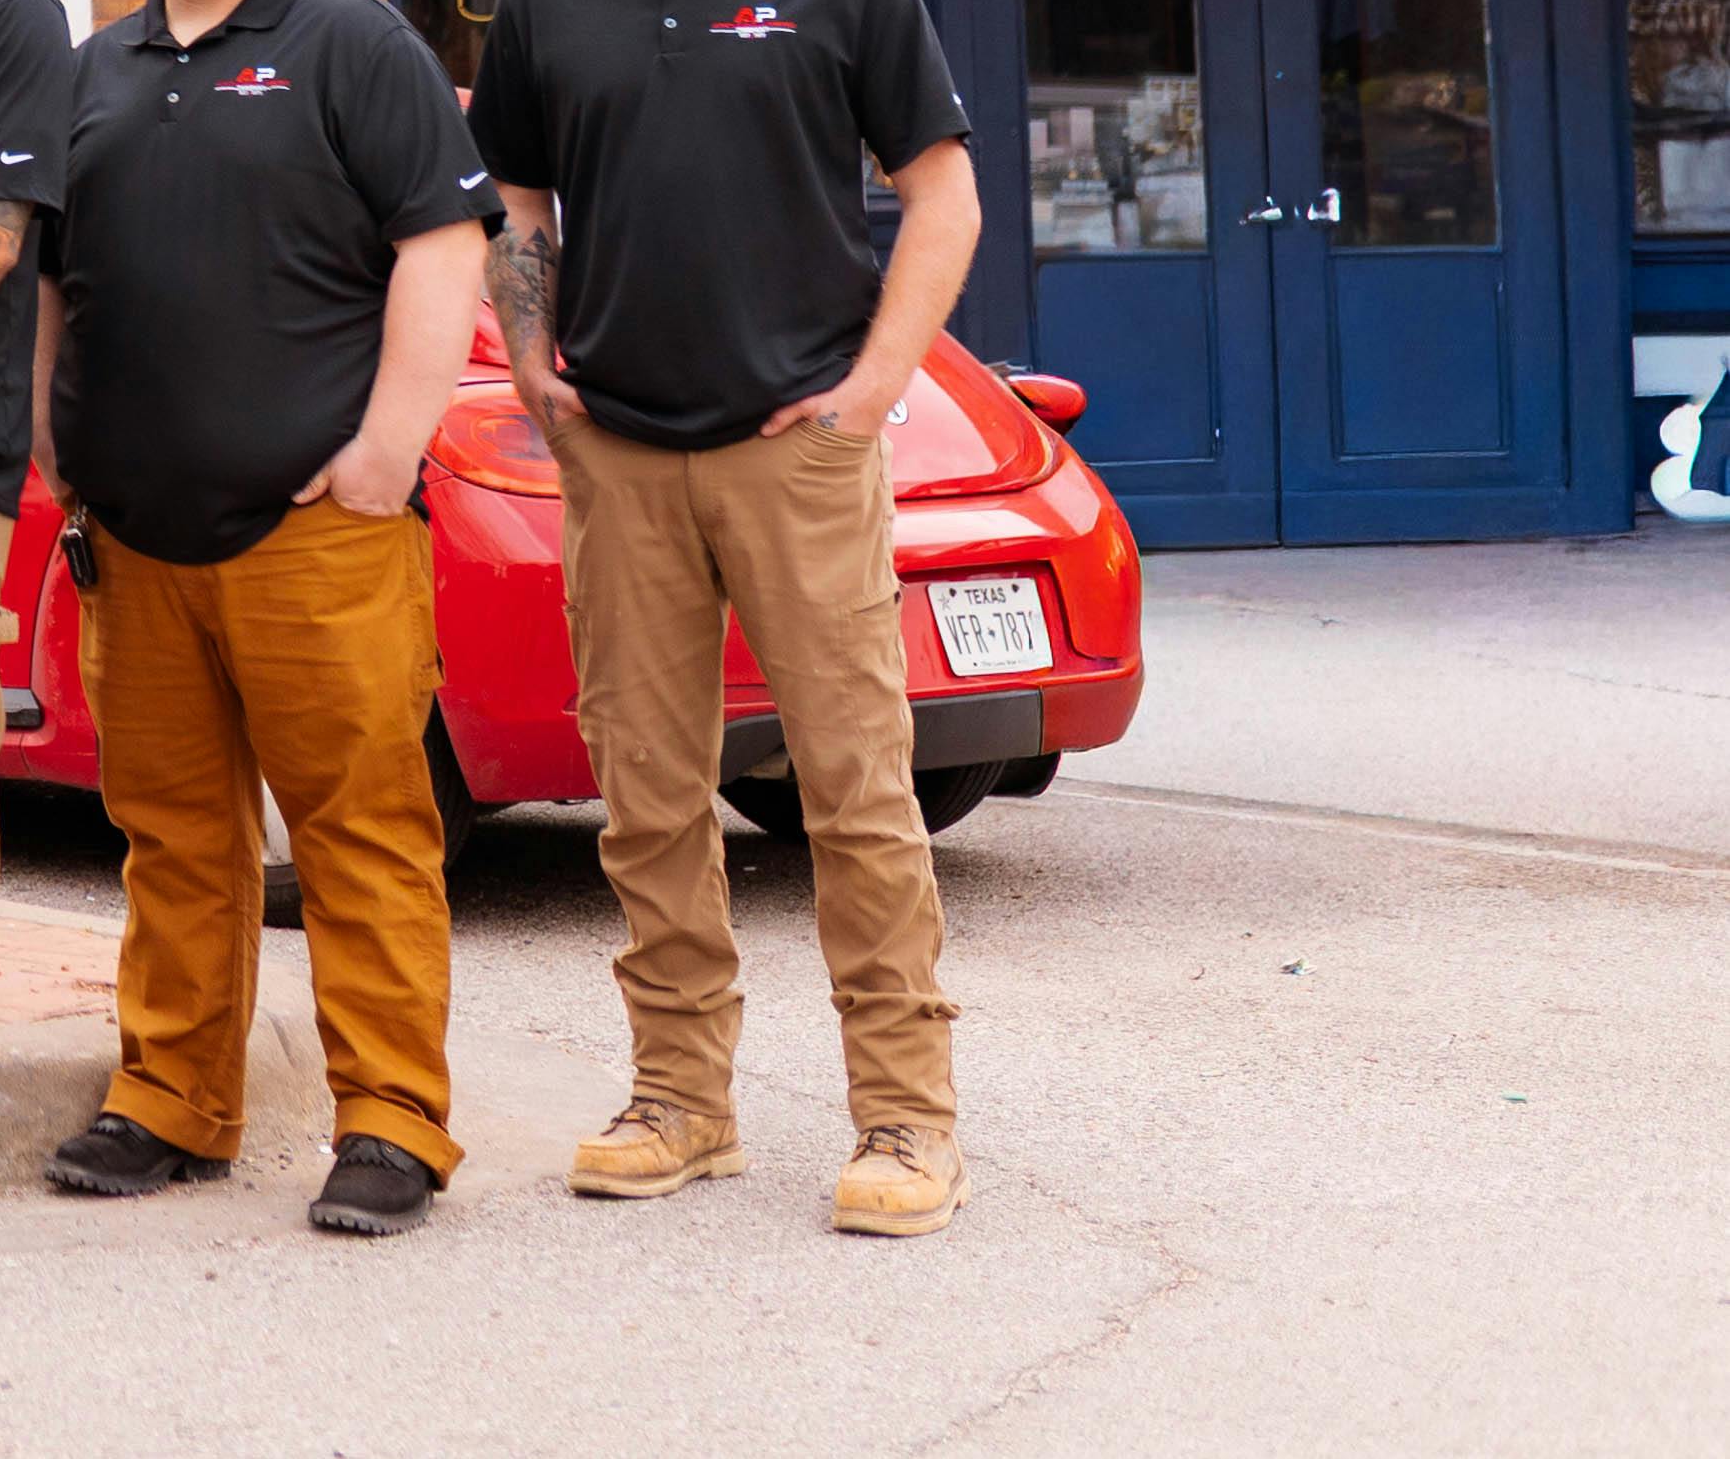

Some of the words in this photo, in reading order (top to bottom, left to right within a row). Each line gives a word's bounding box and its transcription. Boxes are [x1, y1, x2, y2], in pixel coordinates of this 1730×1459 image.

[734, 6, 777, 23] AP
[236, 66, 276, 83] AP
[964, 587, 1007, 605] TEXAS
